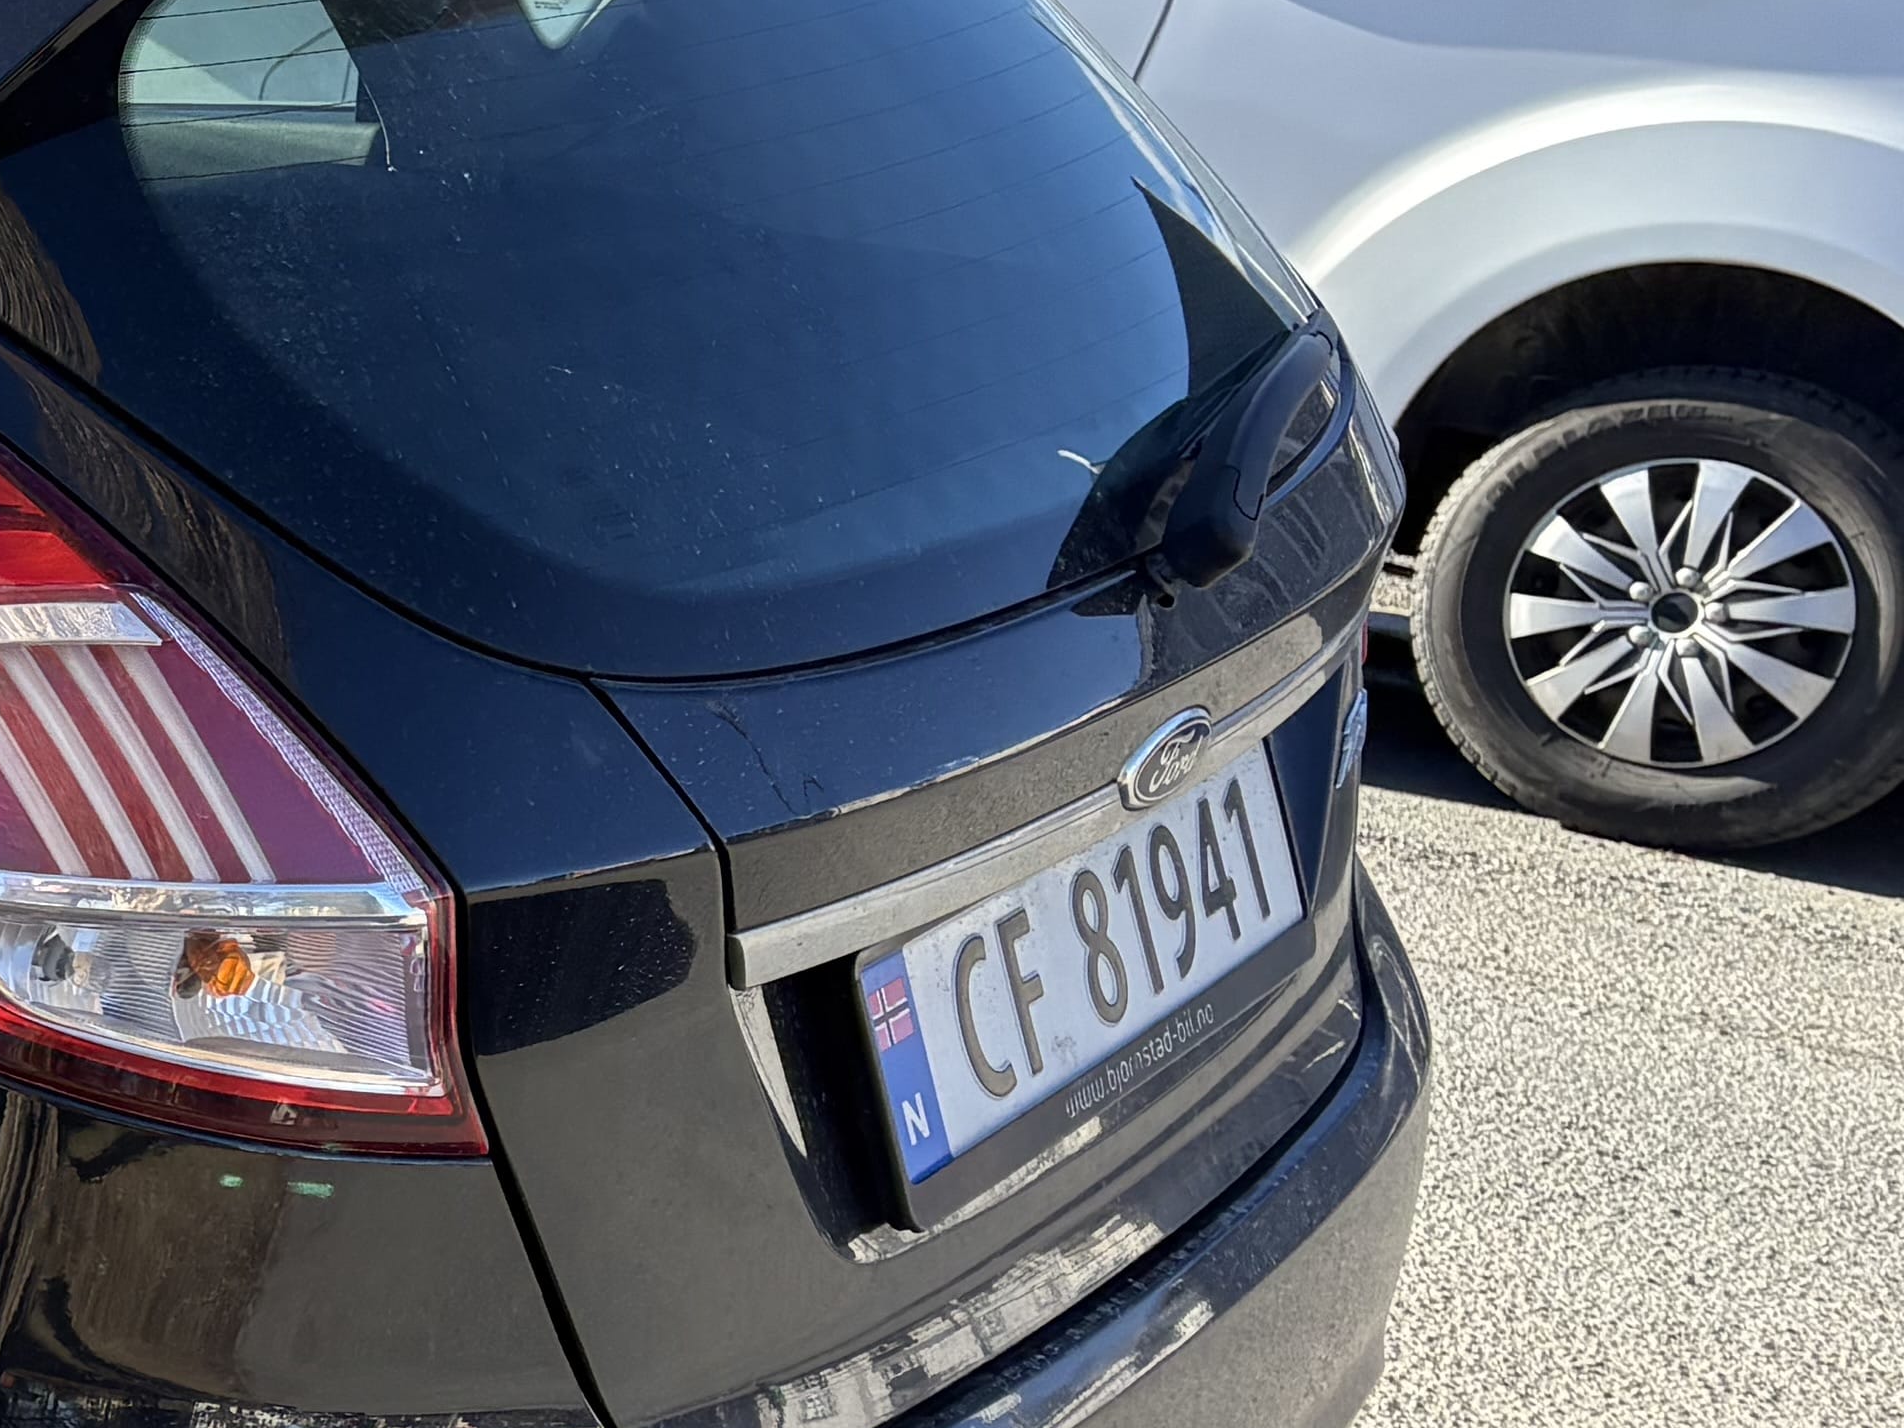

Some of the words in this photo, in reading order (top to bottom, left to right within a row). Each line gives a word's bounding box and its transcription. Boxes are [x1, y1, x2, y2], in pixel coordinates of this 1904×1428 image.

[1149, 728, 1205, 793] Ford
[954, 907, 1045, 1099] CF
[1071, 777, 1271, 1025] 81941
[901, 1092, 930, 1146] N
